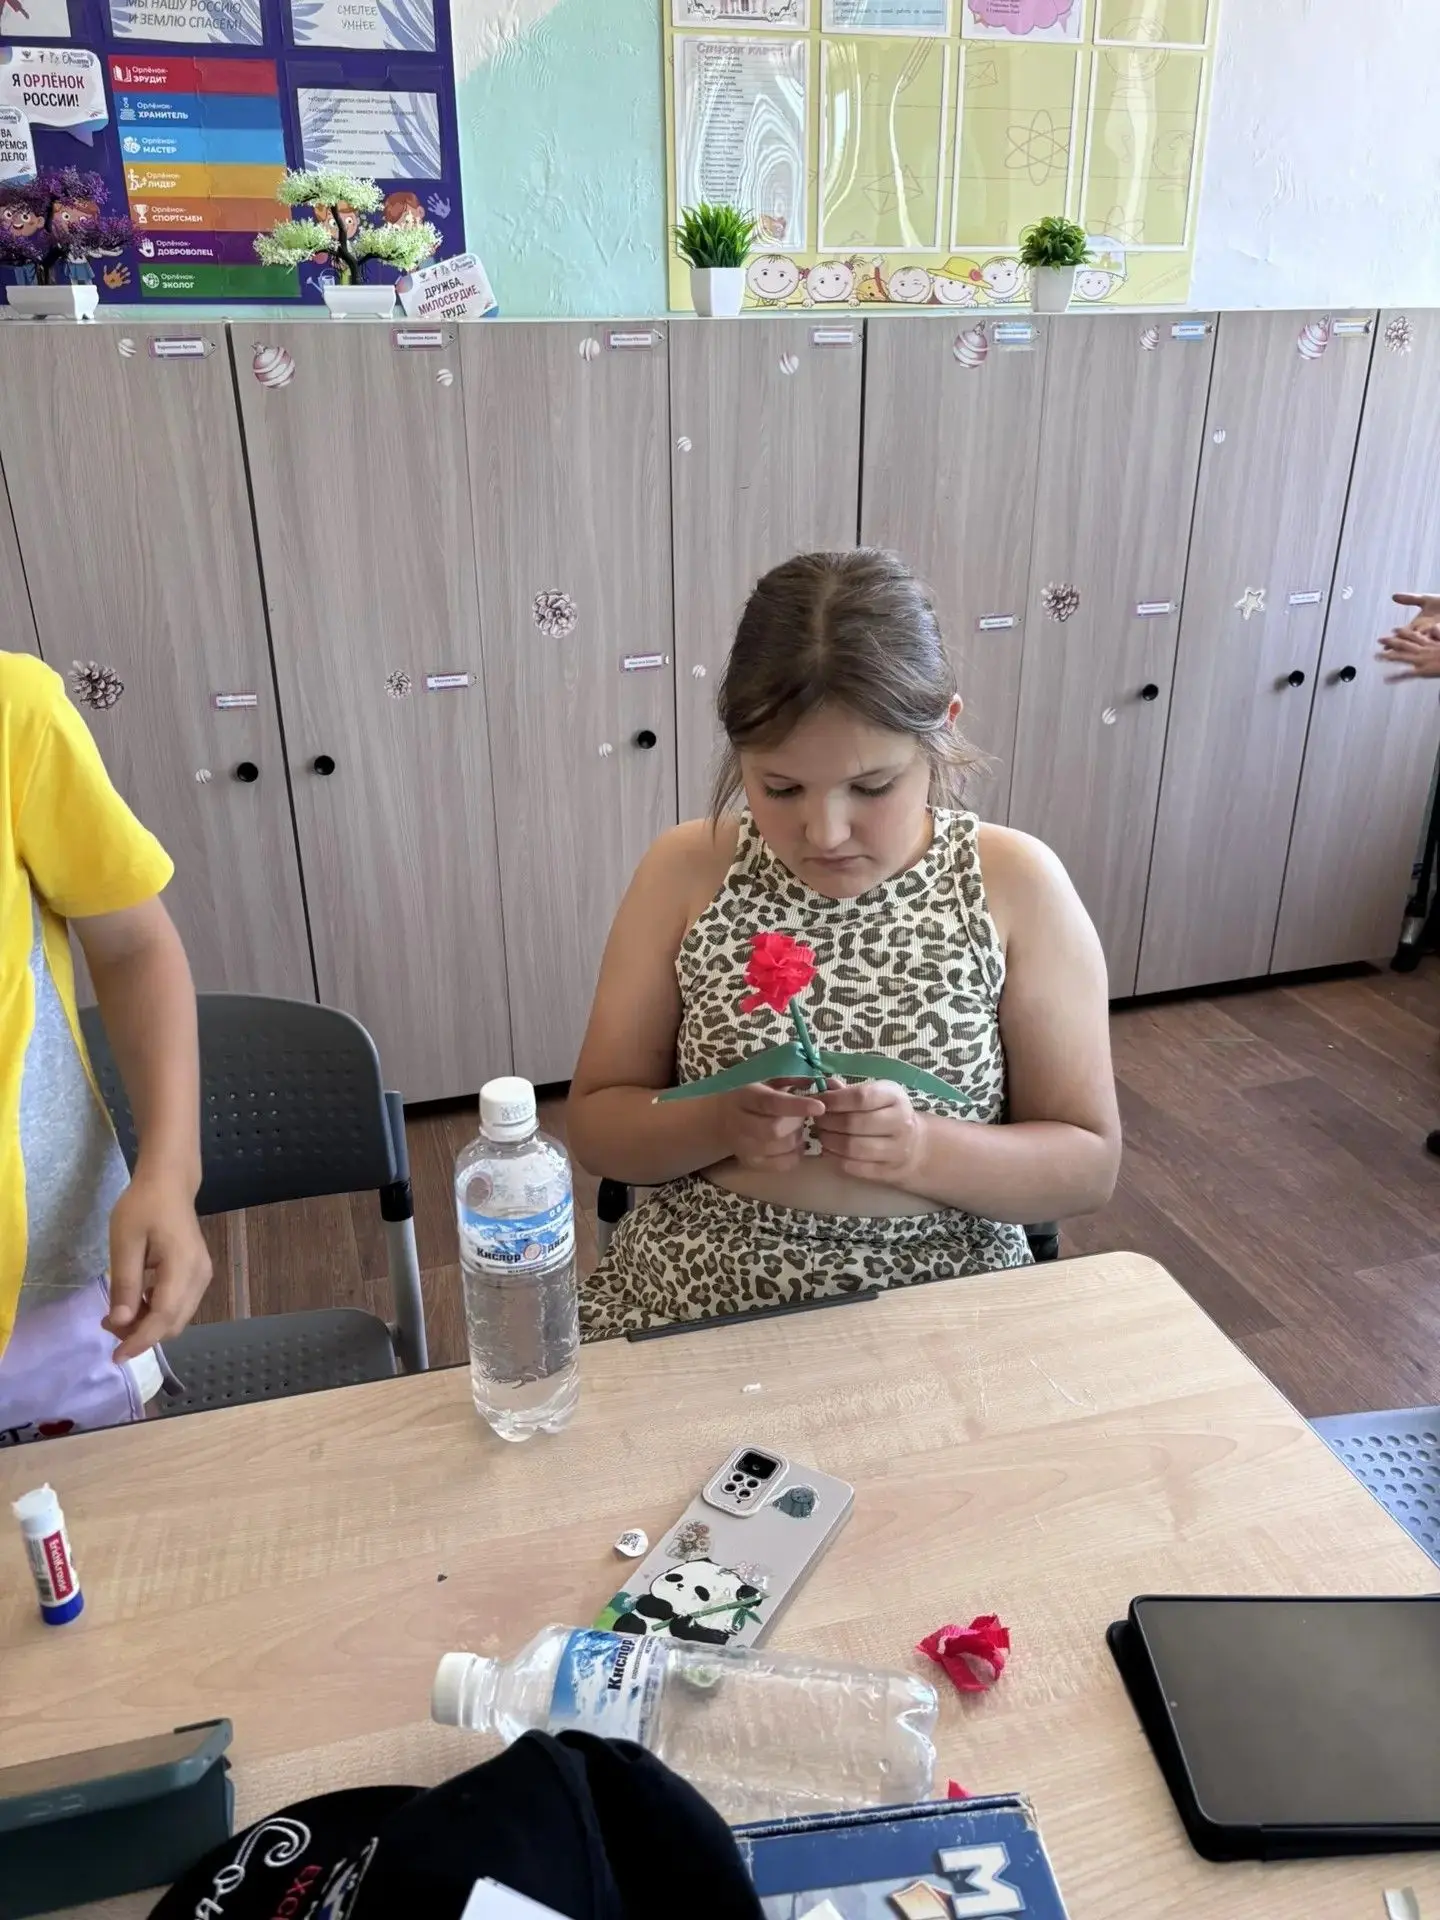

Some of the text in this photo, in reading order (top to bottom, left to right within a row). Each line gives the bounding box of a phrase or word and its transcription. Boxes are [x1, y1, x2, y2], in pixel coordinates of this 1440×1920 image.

[190, 0, 242, 14] РОССИЮ
[140, 14, 187, 27] ЗЕМЛЮ
[12, 72, 85, 89] Я ОРЛЁНОК
[132, 75, 167, 84] ЭРУДИТ
[23, 92, 80, 107] РОССИИ!
[139, 111, 189, 120] ХРАНИТЕЛЬ
[142, 146, 177, 154] МАСТЕР
[148, 181, 177, 189] ЛИДЕР
[152, 214, 203, 222] СПОРТСМЕН
[157, 248, 214, 257] ДОБРОВОЛЕЦ
[424, 277, 465, 300] ДРУЖБА,
[417, 285, 481, 315] МИЛОСЕРДИЕ,
[440, 304, 468, 319] ТРУД!
